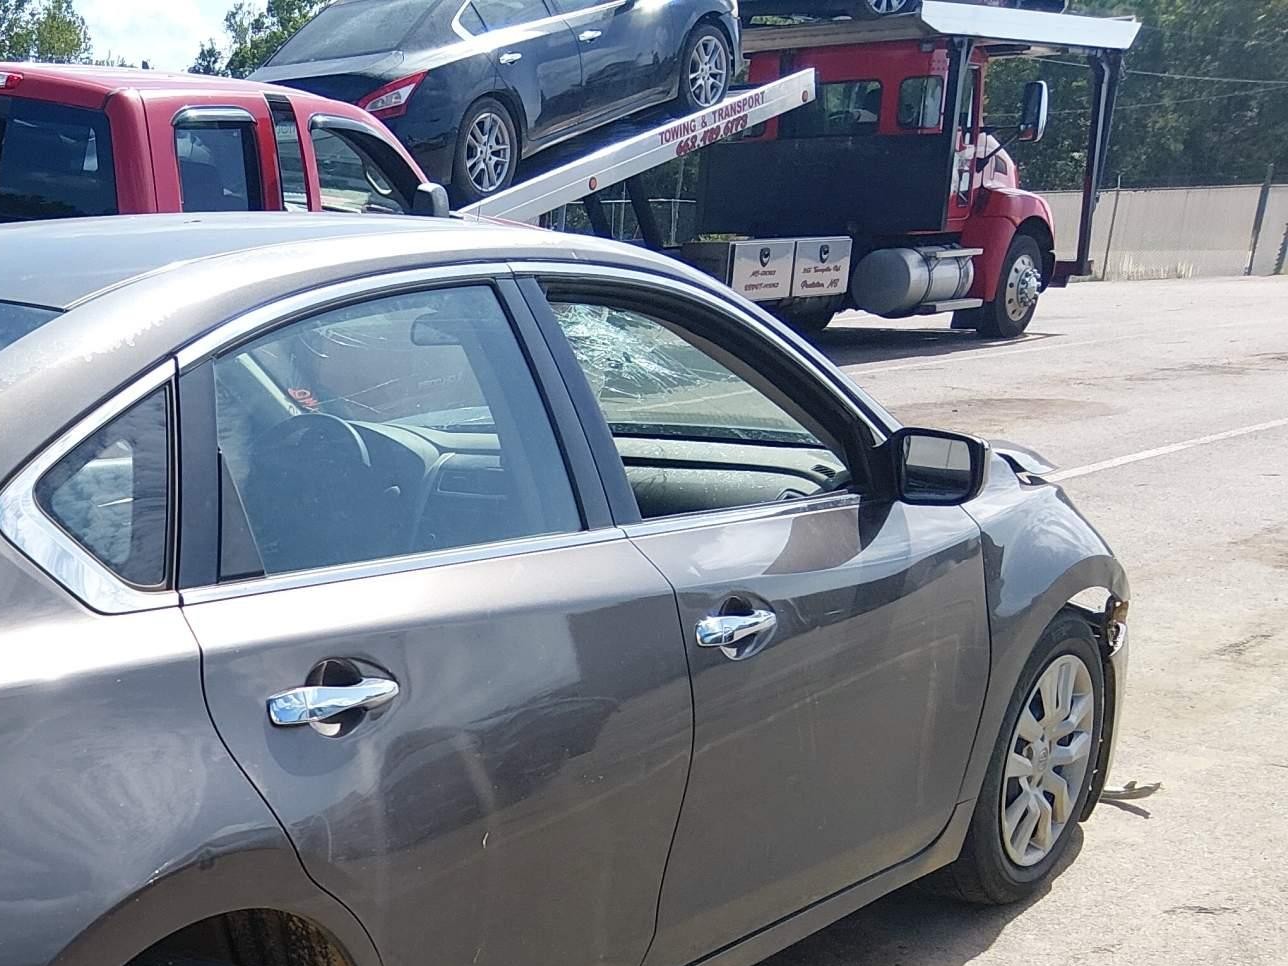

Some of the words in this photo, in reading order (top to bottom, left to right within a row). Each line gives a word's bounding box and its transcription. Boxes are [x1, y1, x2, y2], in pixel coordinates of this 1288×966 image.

[658, 118, 696, 145] TOWING
[701, 115, 708, 127] &
[712, 90, 766, 123] TRANSPORT
